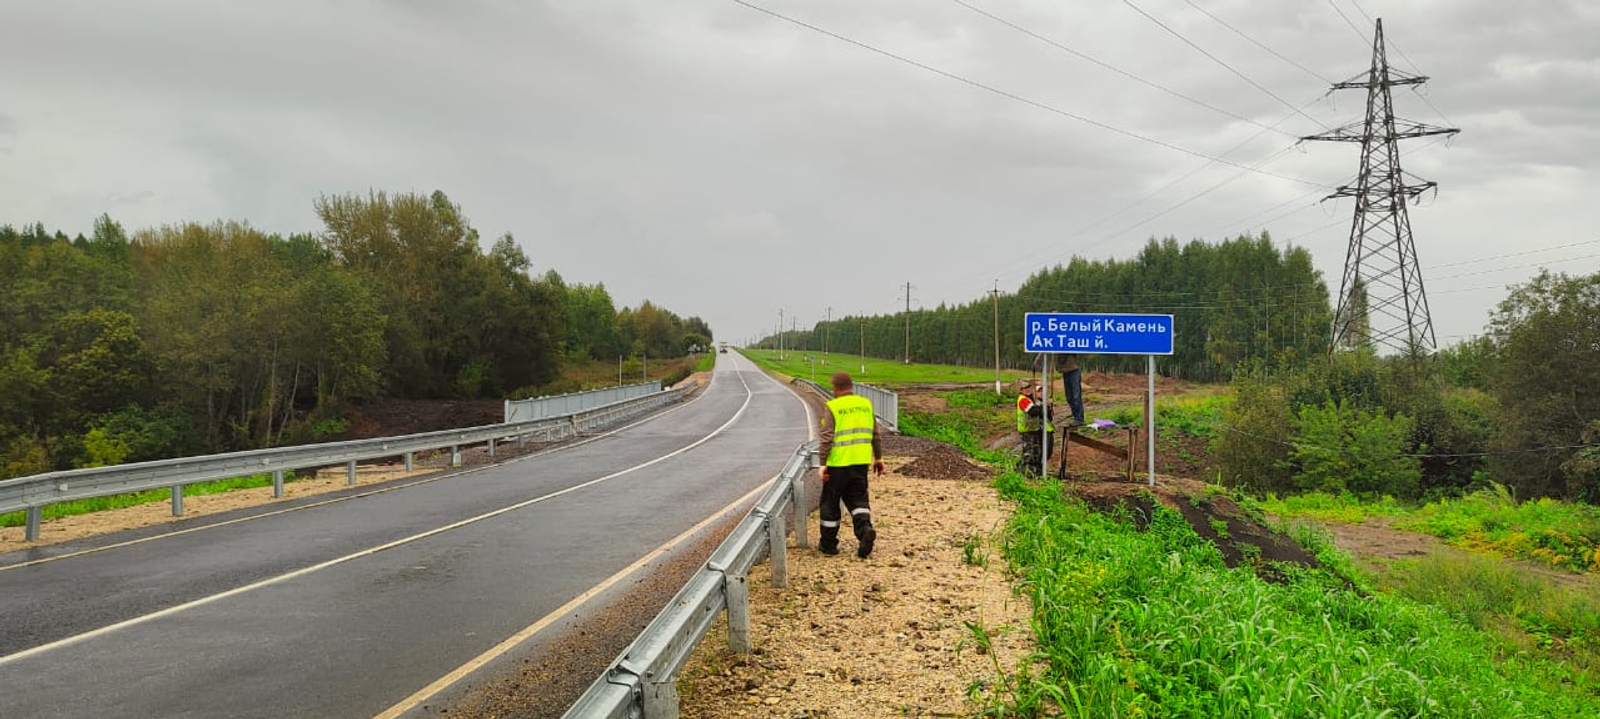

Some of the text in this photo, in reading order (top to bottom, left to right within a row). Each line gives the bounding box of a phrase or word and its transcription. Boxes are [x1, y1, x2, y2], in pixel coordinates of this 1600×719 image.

[1032, 318, 1166, 334] р. Белый Камень
[1057, 334, 1090, 348] Таш
[1094, 335, 1108, 349] й.
